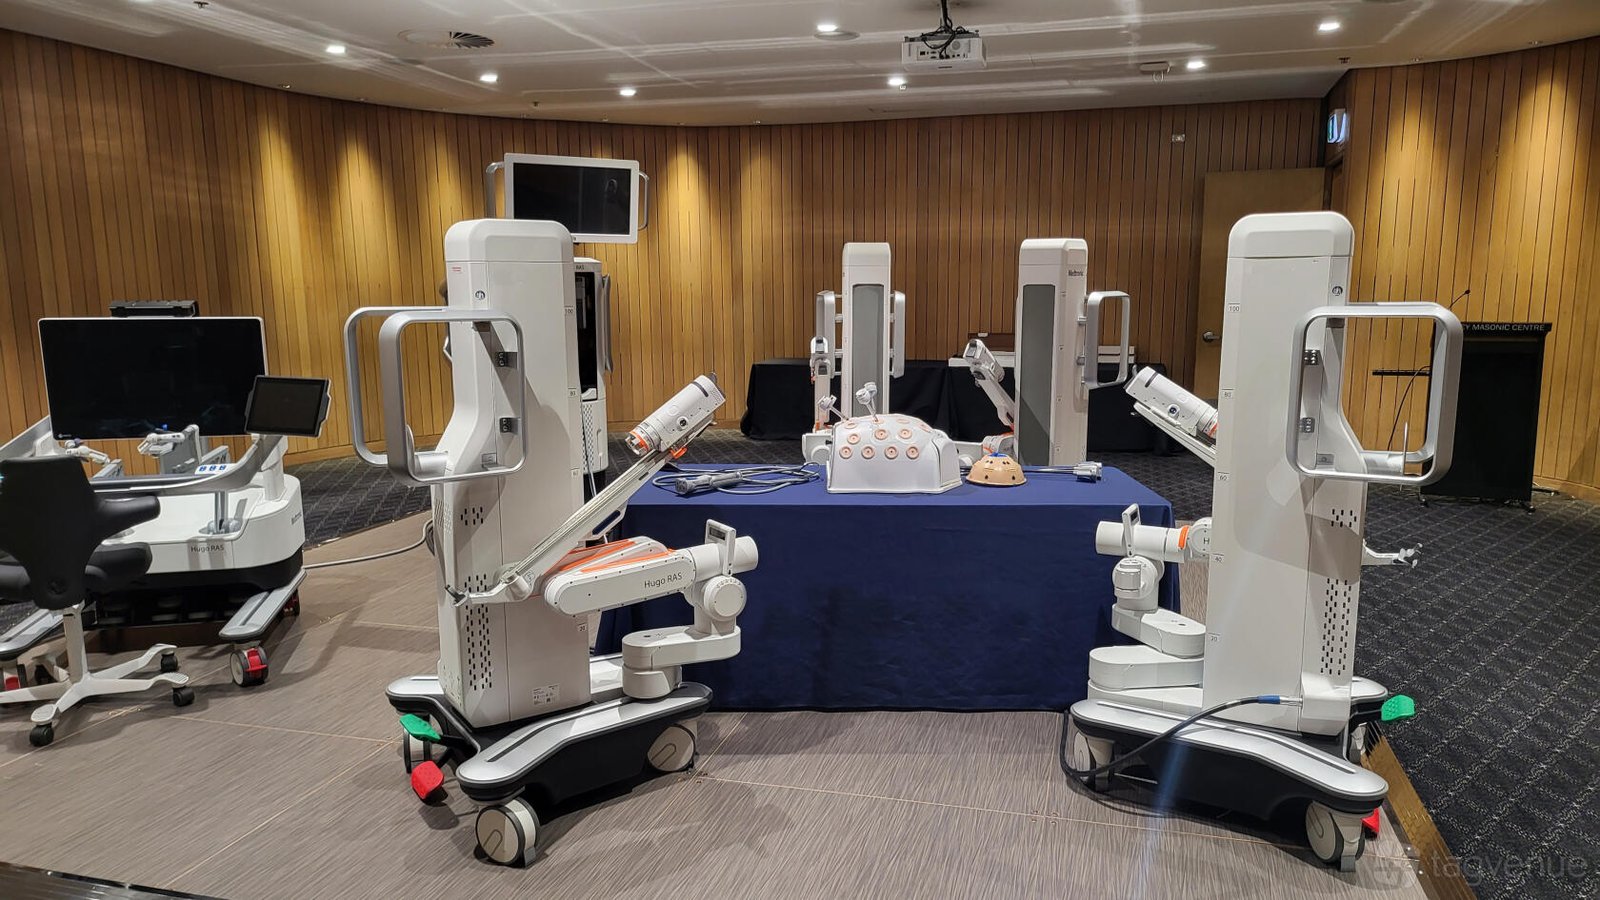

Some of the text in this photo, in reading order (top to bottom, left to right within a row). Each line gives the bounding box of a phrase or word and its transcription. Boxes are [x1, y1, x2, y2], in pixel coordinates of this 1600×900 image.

[1472, 323, 1510, 331] MASONIC
[1511, 323, 1545, 331] CENTRE
[190, 545, 210, 553] Hugo
[644, 571, 683, 589] Hugo RAS
